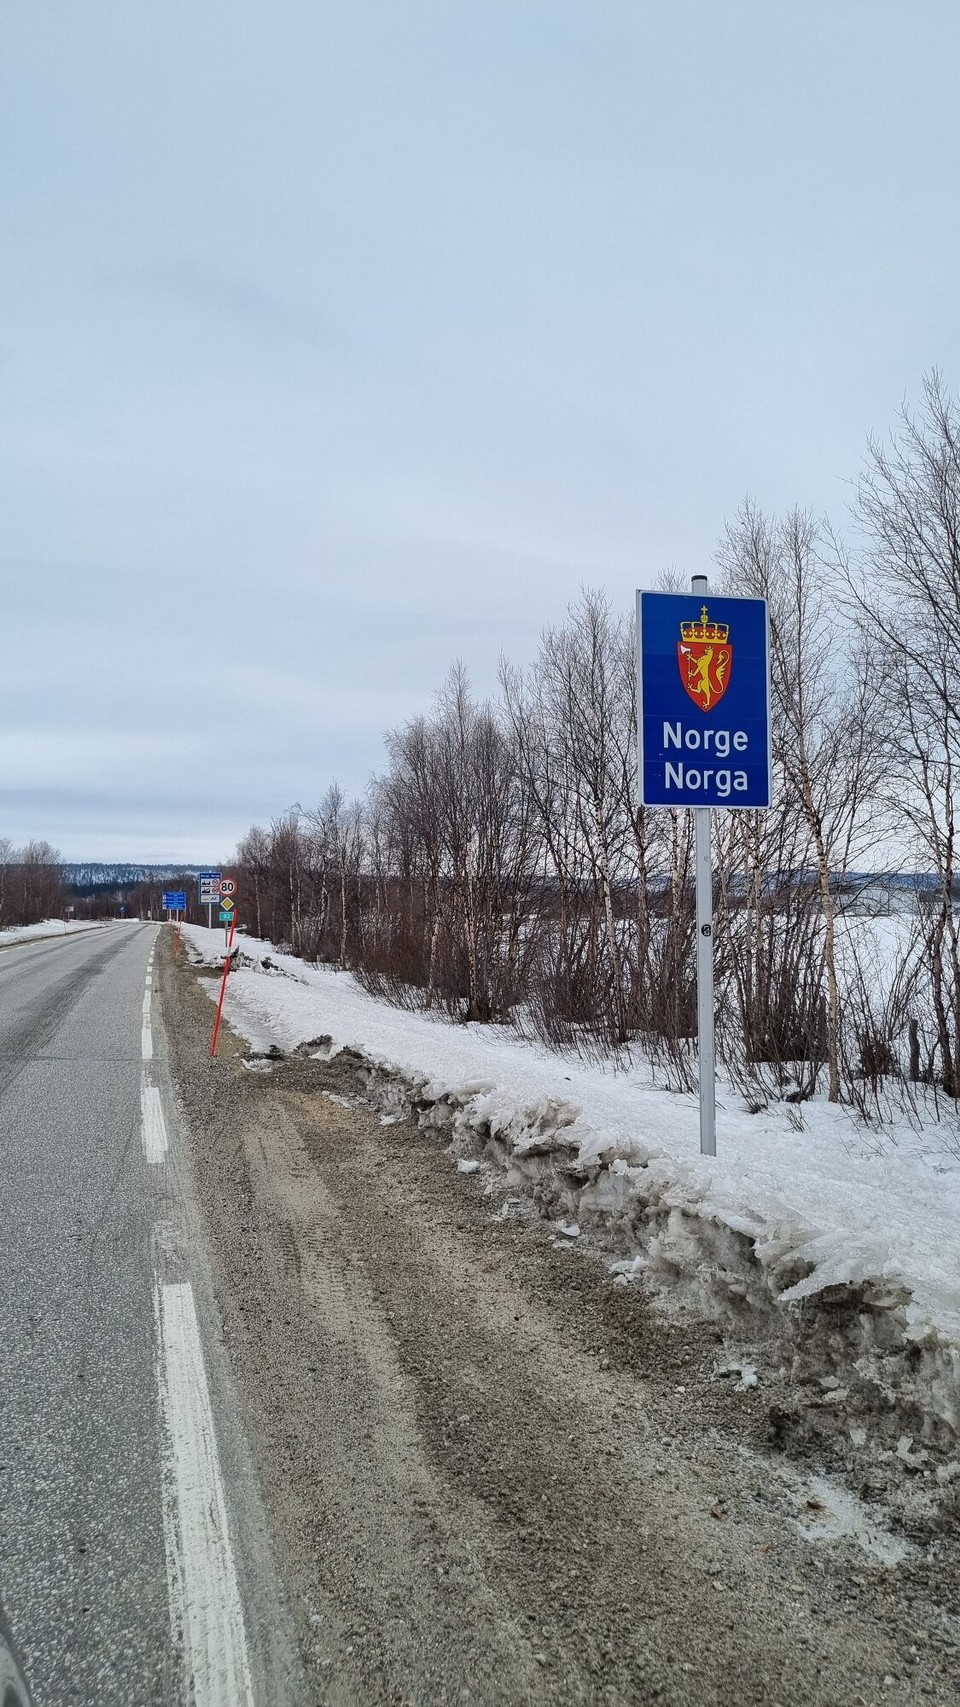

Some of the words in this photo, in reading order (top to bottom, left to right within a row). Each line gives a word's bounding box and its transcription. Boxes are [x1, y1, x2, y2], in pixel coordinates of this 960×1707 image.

[663, 721, 749, 758] Norge
[665, 762, 748, 797] Norga
[221, 882, 233, 892] 80
